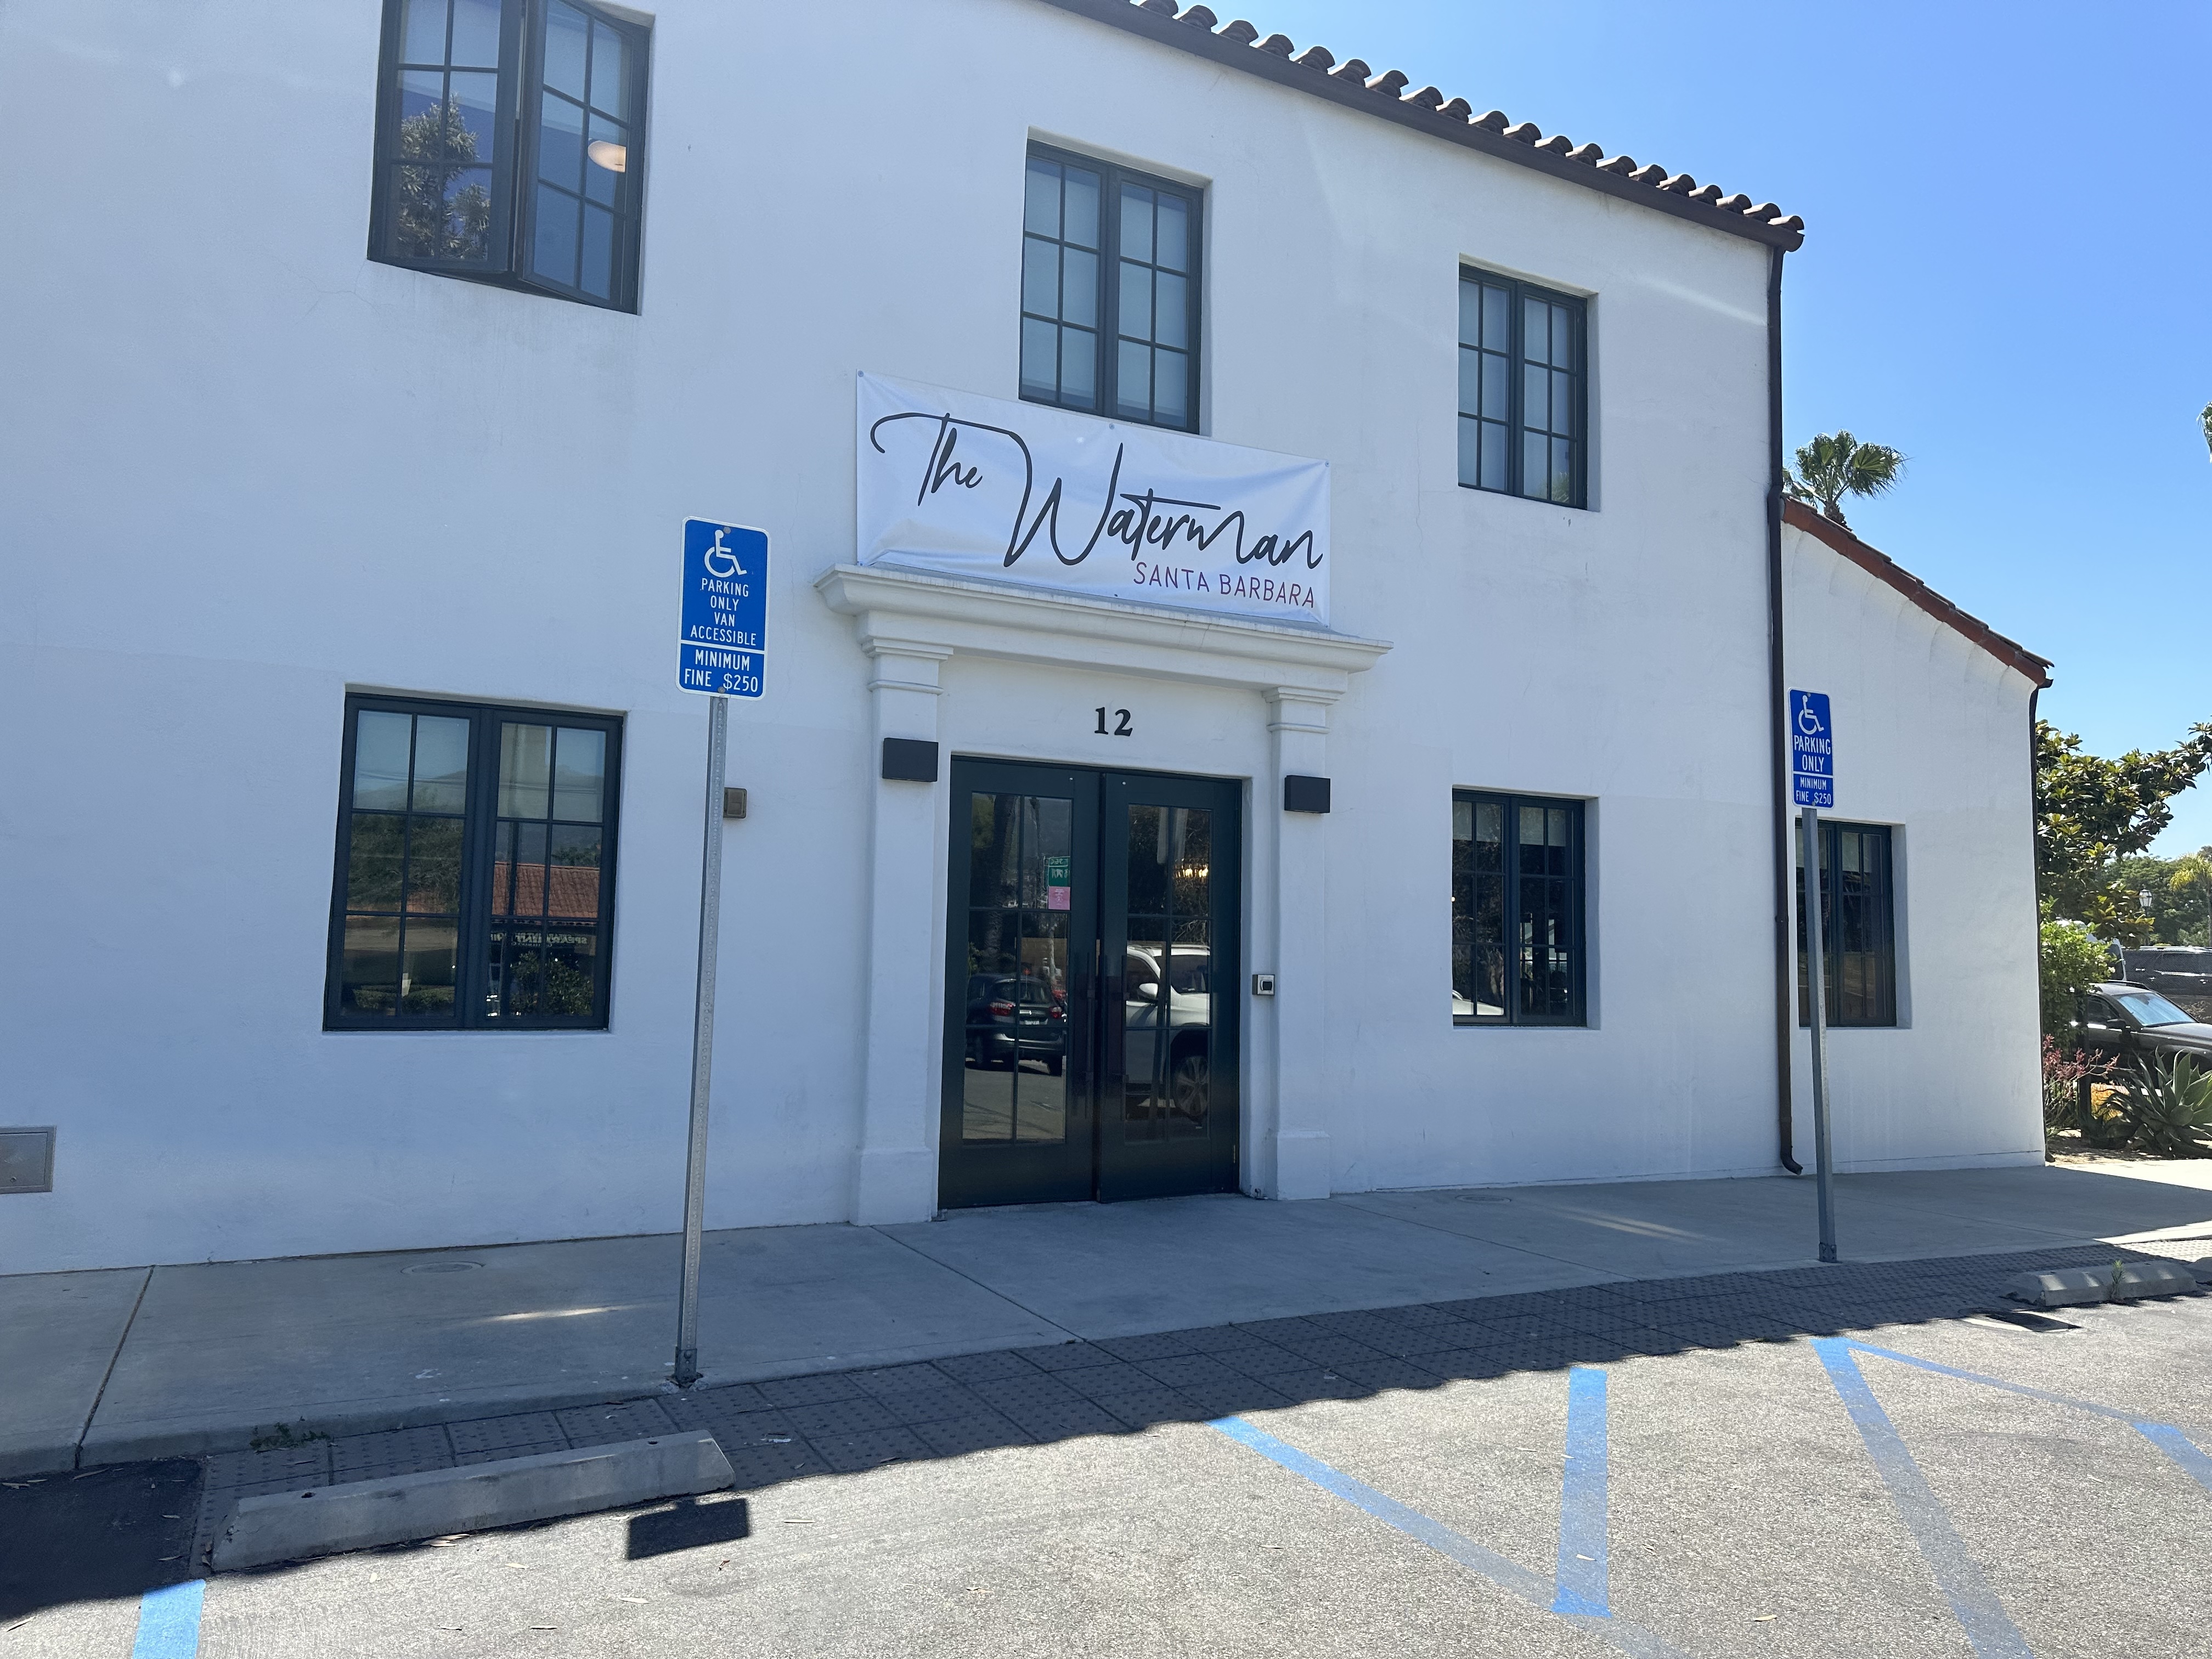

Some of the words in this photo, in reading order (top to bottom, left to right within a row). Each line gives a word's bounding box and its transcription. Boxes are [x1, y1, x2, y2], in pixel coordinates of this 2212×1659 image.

[870, 412, 1009, 506] The
[1003, 430, 1323, 569] Waterman
[701, 578, 749, 597] PARKING
[1133, 561, 1210, 592] SANTA
[1219, 573, 1314, 608] BARBARA
[710, 595, 740, 612] ONLY
[714, 612, 735, 627] VAN
[690, 624, 757, 646] ACCESSIBLE
[695, 649, 751, 672] MINIMUM
[684, 668, 713, 687] FINE
[722, 672, 759, 693] $250
[1094, 706, 1133, 737] 12
[1794, 735, 1831, 755] PARKING
[1802, 754, 1824, 772] ONLY
[1800, 776, 1826, 791] MINIMUM
[1796, 790, 1809, 802] FINE
[1814, 792, 1831, 805] $250
